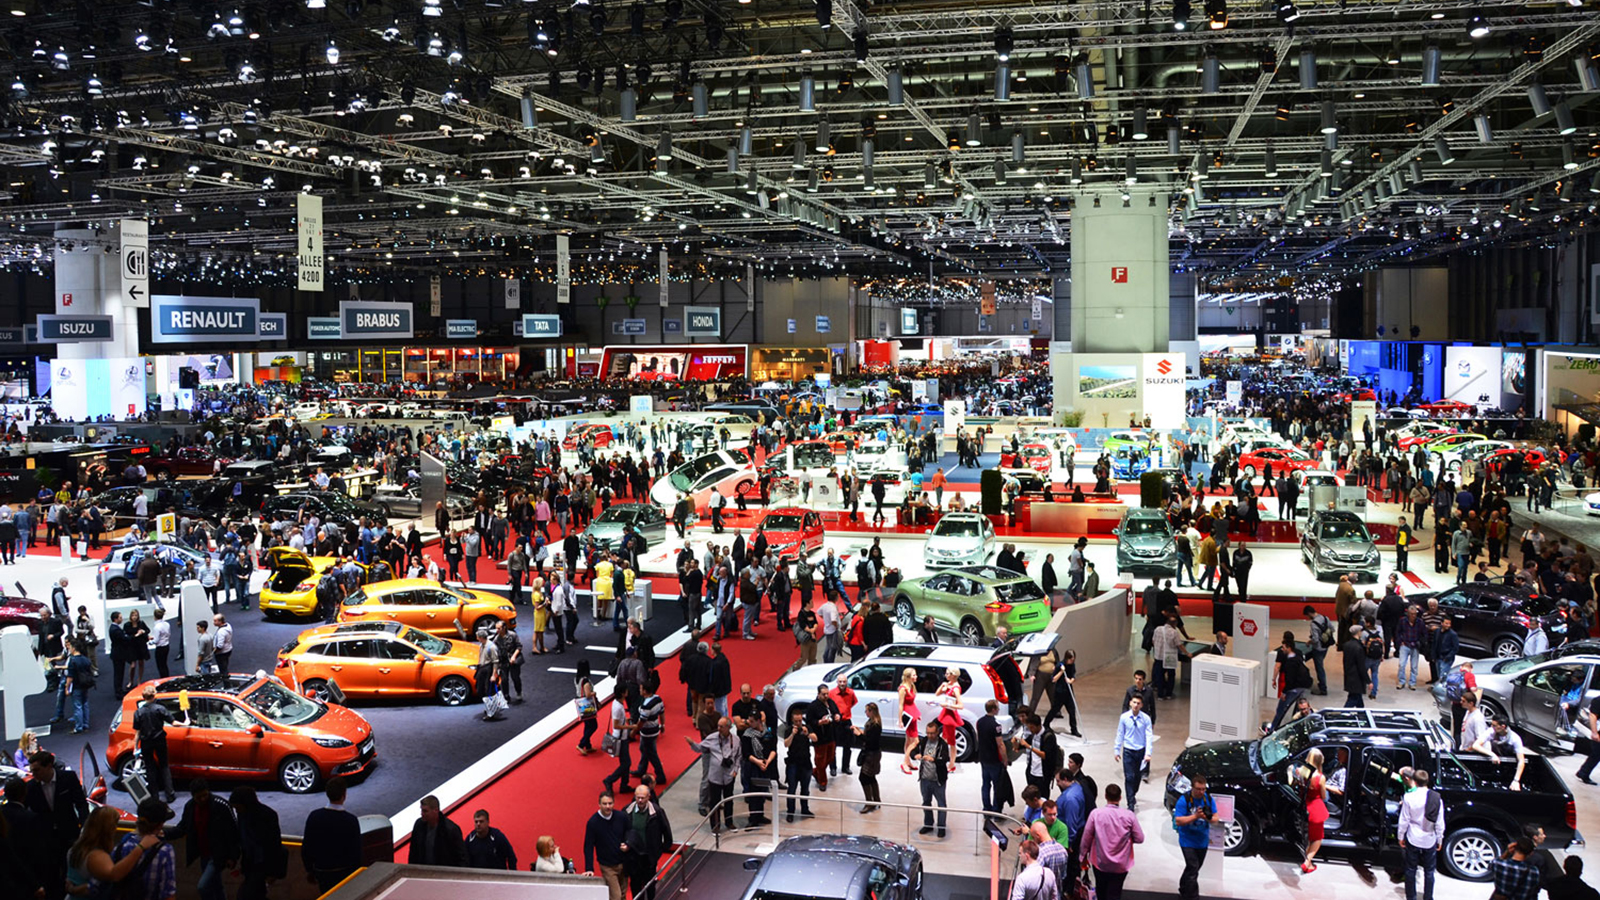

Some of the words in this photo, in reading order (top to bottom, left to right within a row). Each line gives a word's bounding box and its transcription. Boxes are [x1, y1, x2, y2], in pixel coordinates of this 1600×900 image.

[307, 237, 313, 252] 4
[300, 255, 322, 267] ALLEE
[302, 271, 320, 283] 4200
[1116, 268, 1125, 280] F
[171, 311, 246, 329] RENAULT
[356, 313, 400, 327] BRABUS
[534, 320, 550, 331] TATA
[692, 315, 714, 327] HONDA
[59, 323, 95, 334] ISUZU
[702, 355, 736, 364] Ferrari
[1569, 359, 1598, 370] ZERO
